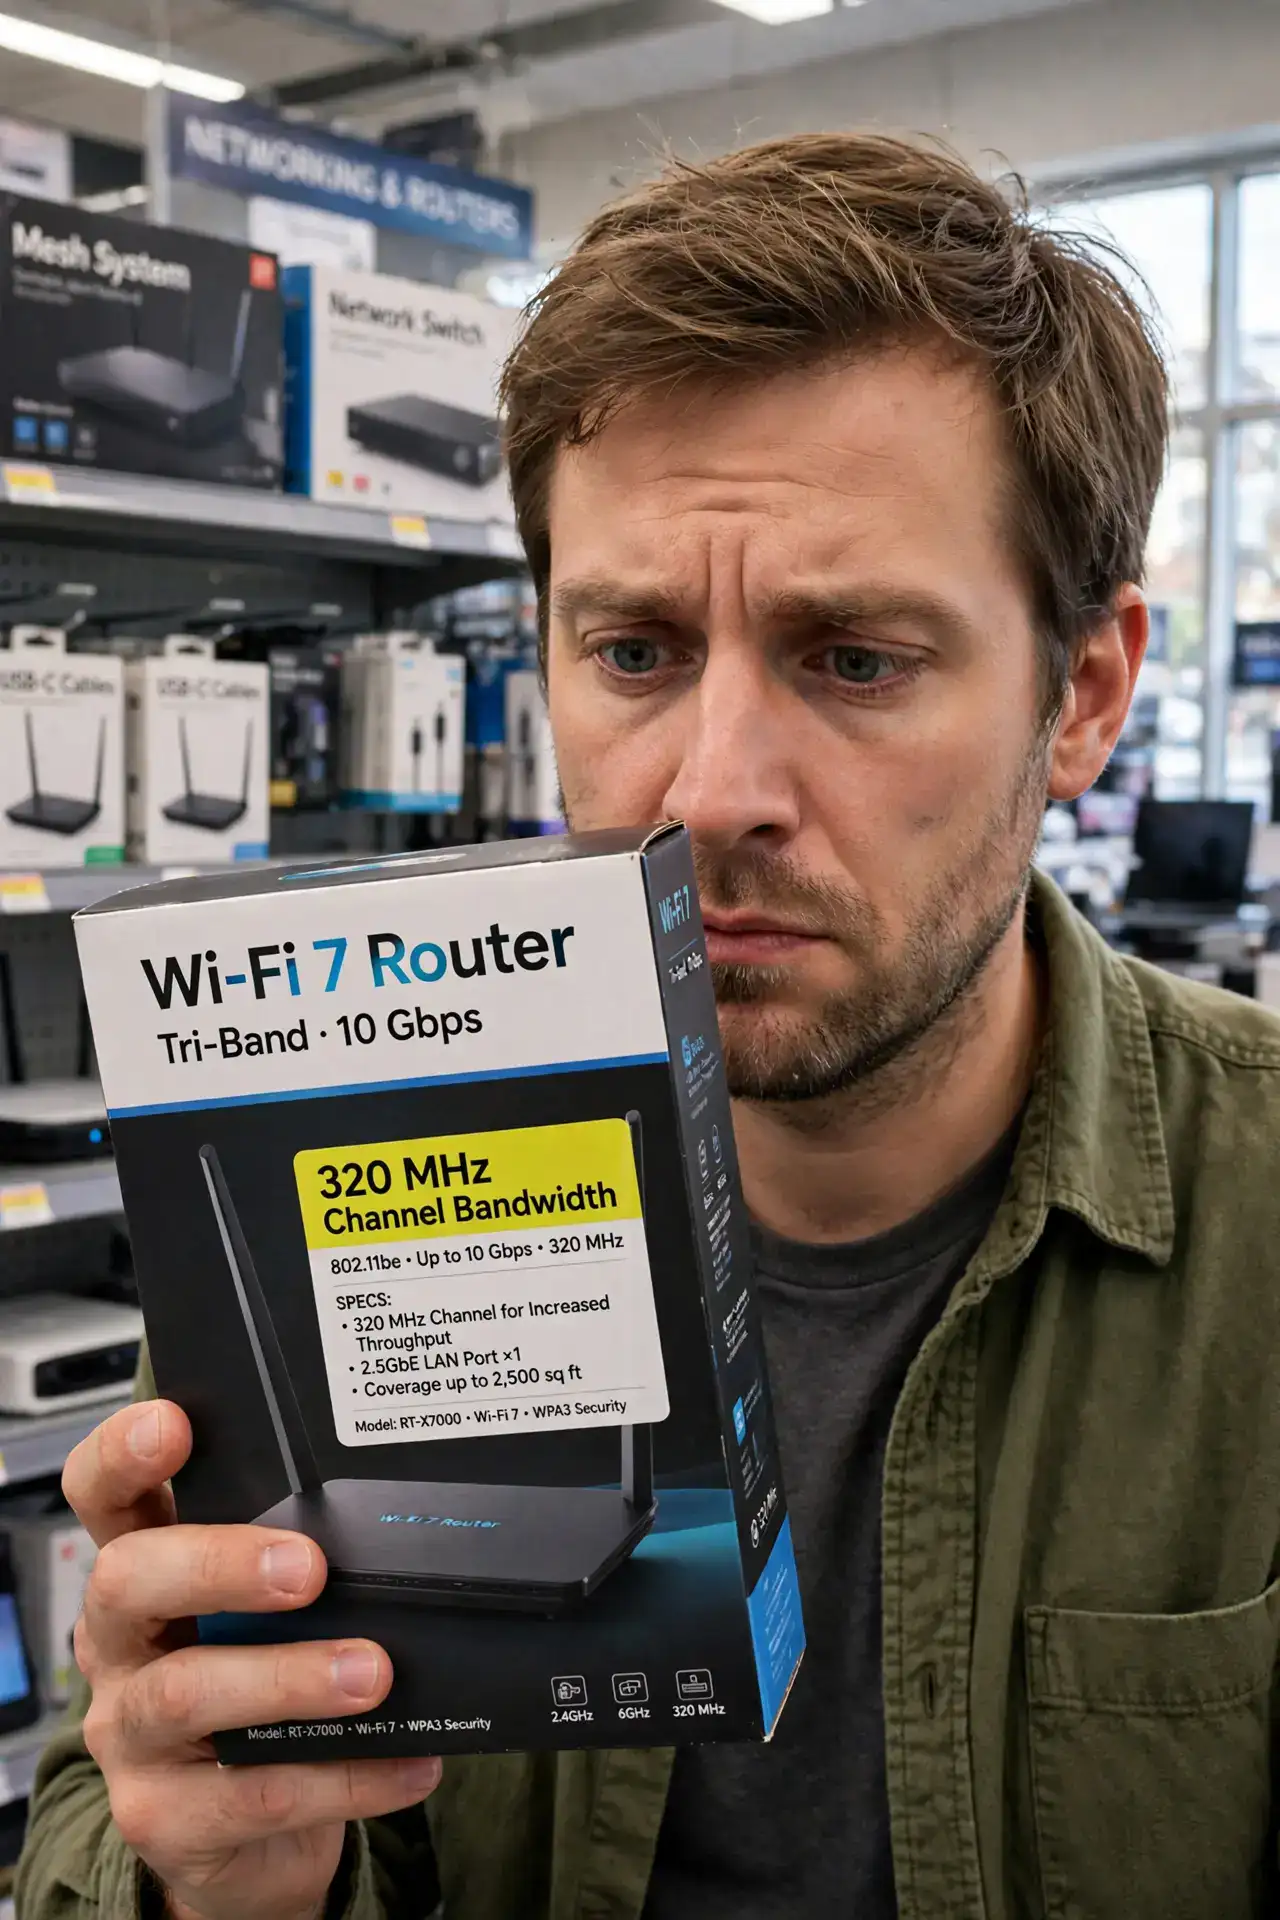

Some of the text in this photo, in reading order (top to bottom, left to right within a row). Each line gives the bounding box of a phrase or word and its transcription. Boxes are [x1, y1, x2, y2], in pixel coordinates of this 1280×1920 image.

[184, 116, 519, 240] NETWORKING & ROUTERS
[12, 222, 91, 273] Mesh
[93, 240, 192, 293] System
[330, 290, 414, 333] Network
[422, 309, 484, 347] Switch
[659, 889, 685, 933] Wi-Fi
[140, 923, 574, 1010] Wi-Fi 7 Router
[157, 1006, 483, 1064] Tri-Band 10 Gbps
[317, 1152, 492, 1199] 320 MHz
[324, 1181, 617, 1235] Channel Bandwidth
[331, 1232, 625, 1275] 802.11be Up to 10 Gbps 320 MHz
[336, 1292, 391, 1310] SPECS:
[353, 1294, 610, 1332] 320 MHz Channel for Increased
[355, 1331, 453, 1352] Throughput
[361, 1355, 420, 1375] 2.5GbE
[424, 1352, 459, 1370] LAN
[463, 1350, 499, 1366] Port
[364, 1364, 582, 1397] Coverage up to 2,500 sq ft
[355, 1399, 627, 1433] Model: RT-X7000 Wi-Fi 7 WPA3 Security
[440, 1518, 501, 1528] Router
[248, 1717, 491, 1739] Model: RT-X7000 Wi-Fi 7 WPA3 Security
[551, 1710, 594, 1723] 2.4GHz
[618, 1707, 651, 1719] 6GHz
[672, 1703, 726, 1717] 320 MHz
